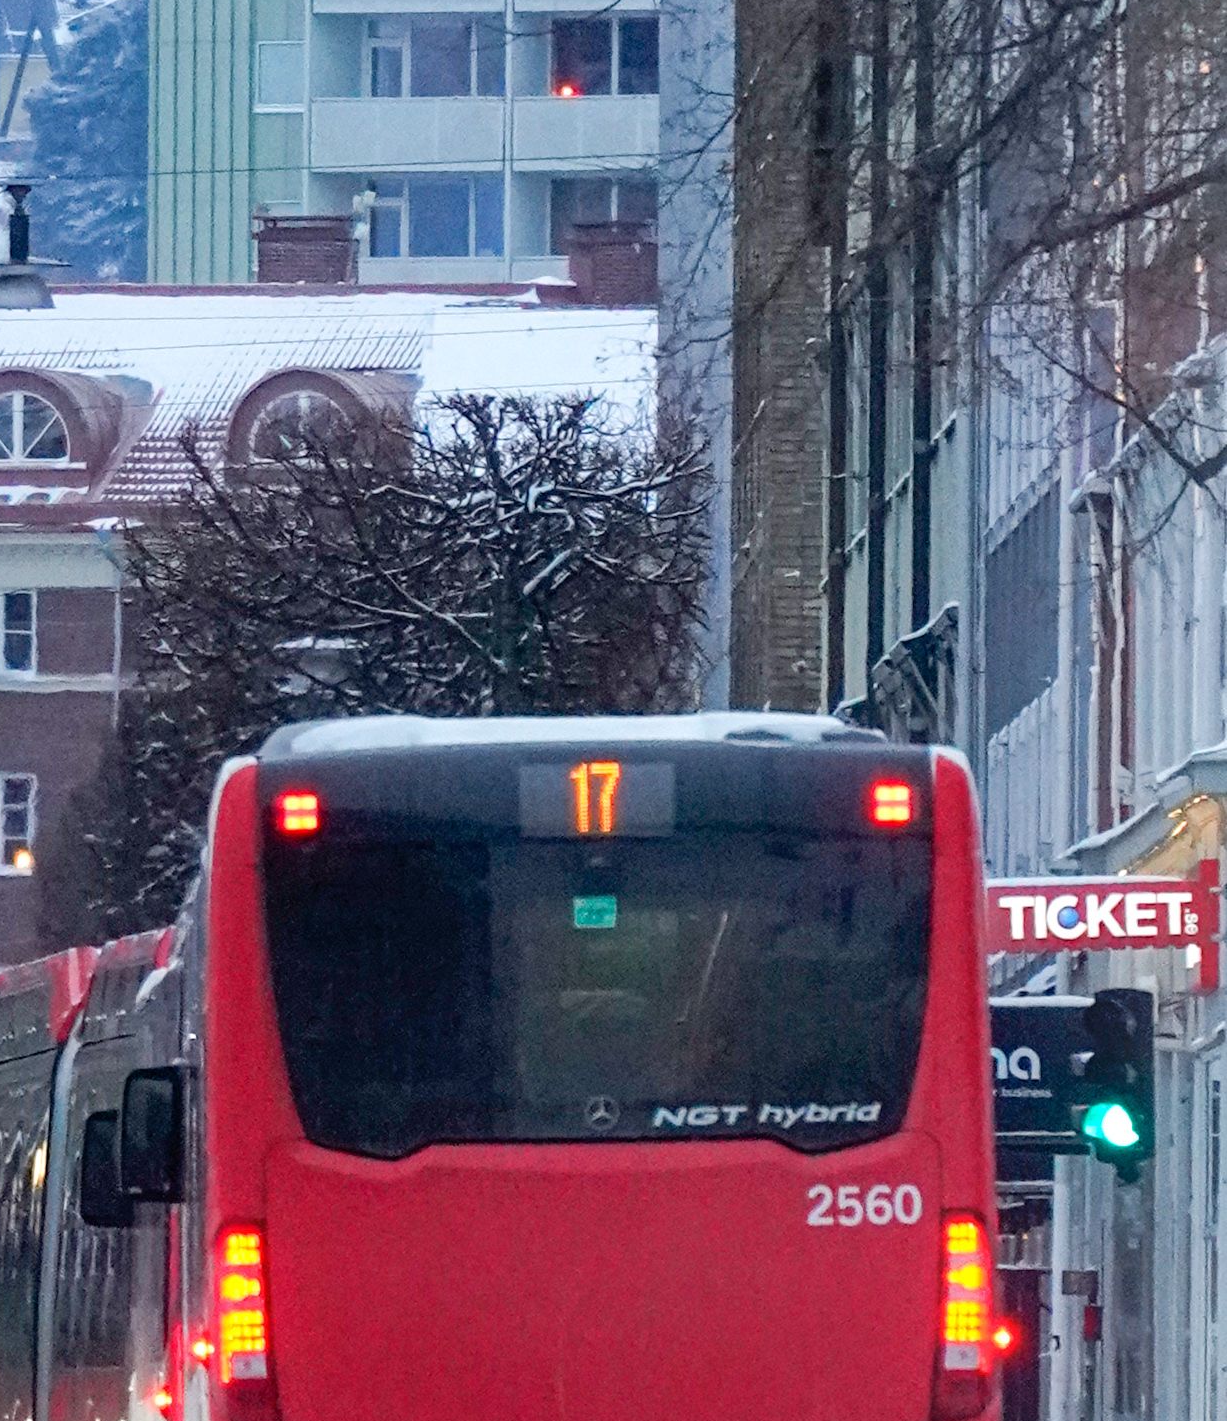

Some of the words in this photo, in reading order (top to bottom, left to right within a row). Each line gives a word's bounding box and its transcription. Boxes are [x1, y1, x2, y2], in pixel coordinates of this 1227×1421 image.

[570, 761, 621, 833] 17
[998, 892, 1193, 940] TICKET
[652, 1105, 748, 1128] NGT
[758, 1101, 882, 1129] hybrid
[806, 1183, 923, 1227] 2560
